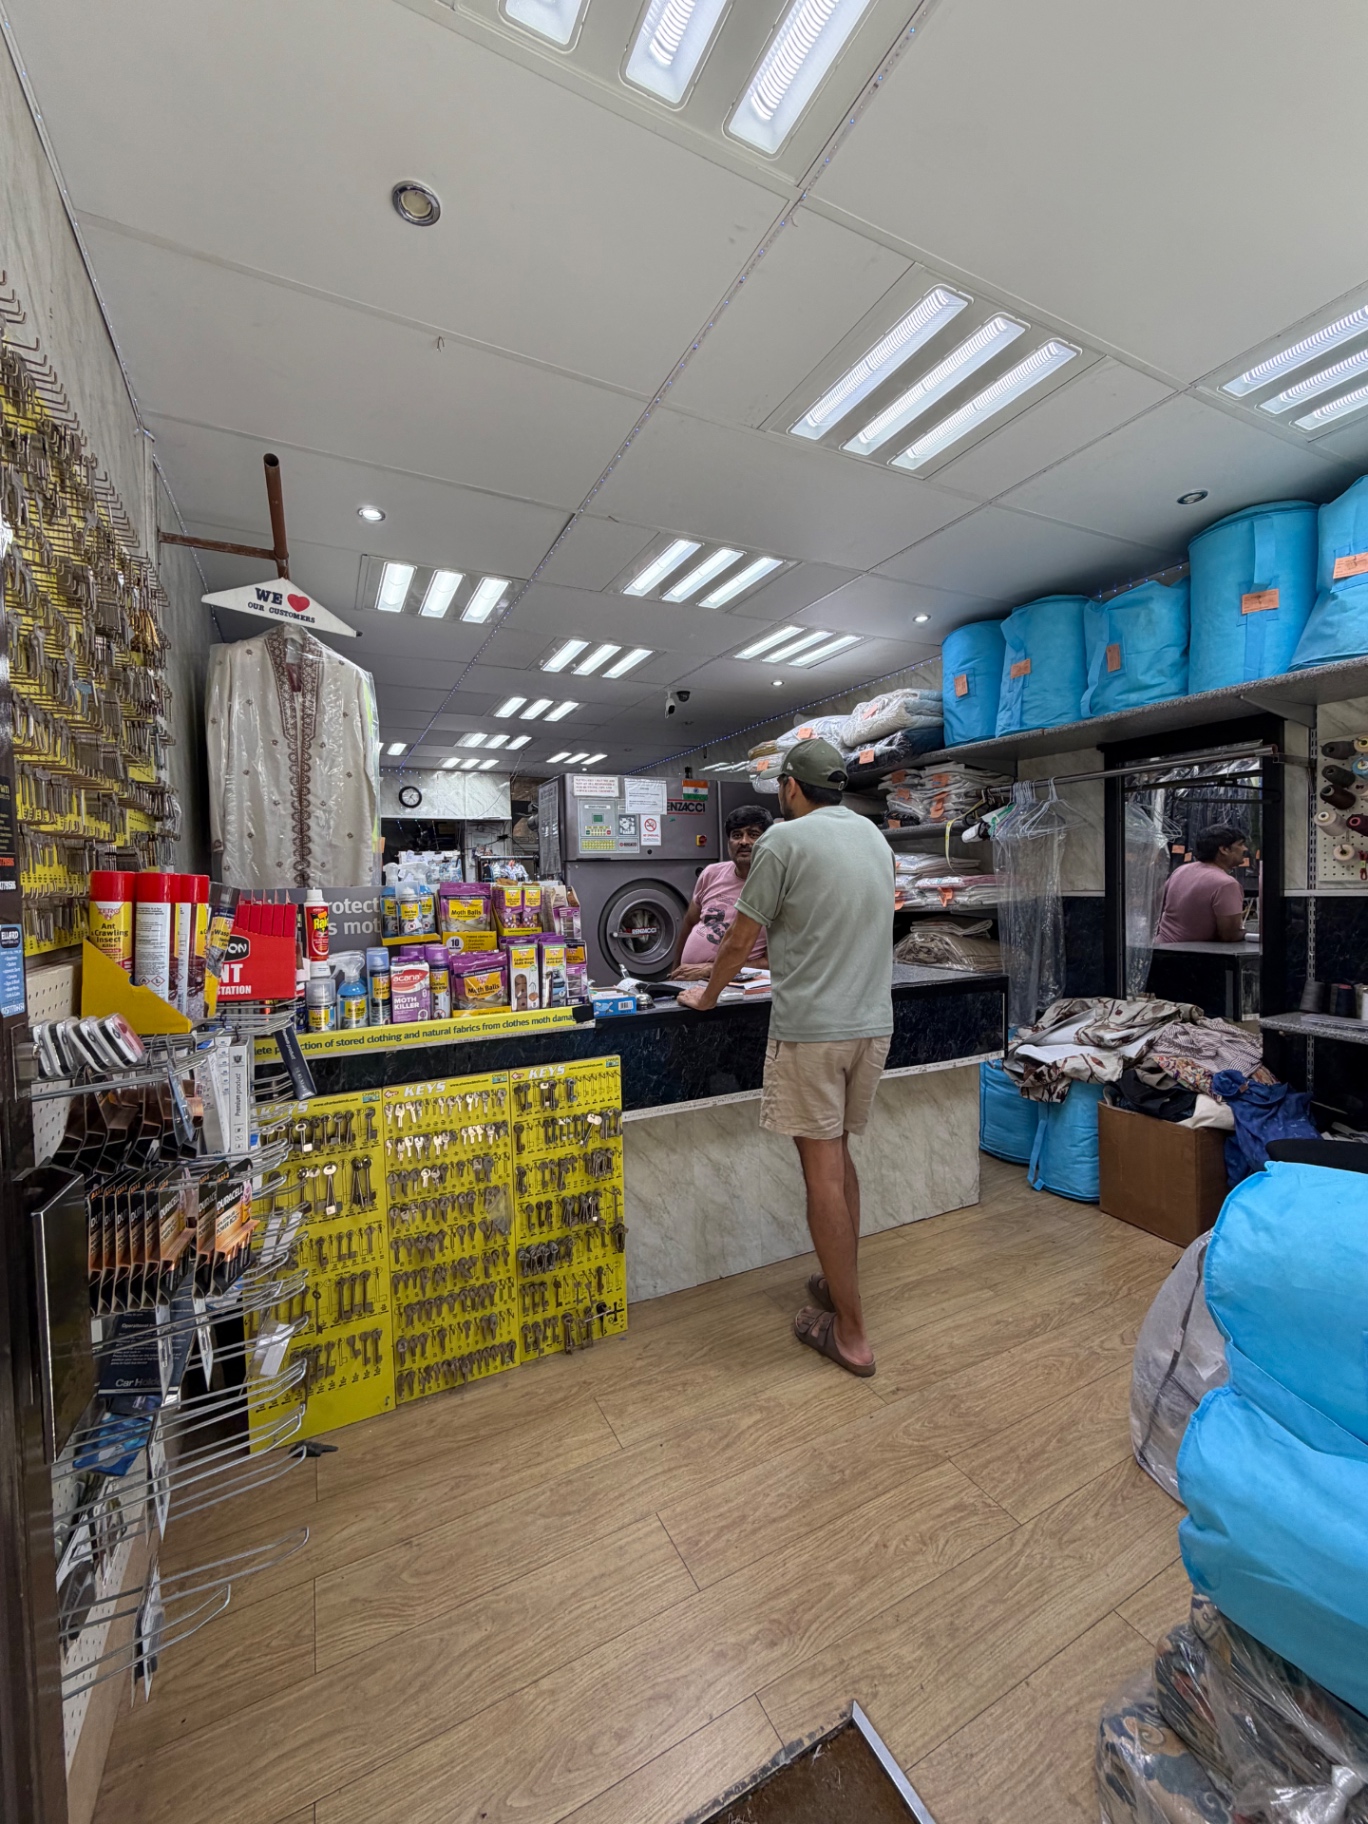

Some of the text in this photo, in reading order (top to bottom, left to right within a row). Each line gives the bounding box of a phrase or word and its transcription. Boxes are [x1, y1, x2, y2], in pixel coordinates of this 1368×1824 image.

[255, 587, 283, 606] WE
[247, 601, 316, 623] OUR CUSTOMERS
[667, 802, 706, 813] ENZACCI
[94, 929, 129, 937] Crawling
[451, 938, 460, 947] 10
[394, 996, 417, 1004] MOTH
[394, 1002, 420, 1010] KILLER
[325, 1038, 335, 1048] of
[336, 1036, 365, 1047] stored
[367, 1032, 402, 1044] clothing
[404, 1030, 420, 1040] and
[422, 1027, 451, 1038] natural
[453, 1024, 481, 1035] fabrics
[482, 1021, 501, 1030] from
[502, 1019, 530, 1029] clothes
[531, 1015, 551, 1025] moth
[528, 1064, 566, 1080] KEYS
[404, 1081, 447, 1098] KEYS
[216, 1185, 244, 1211] DURACELL
[115, 1378, 134, 1387] Car
